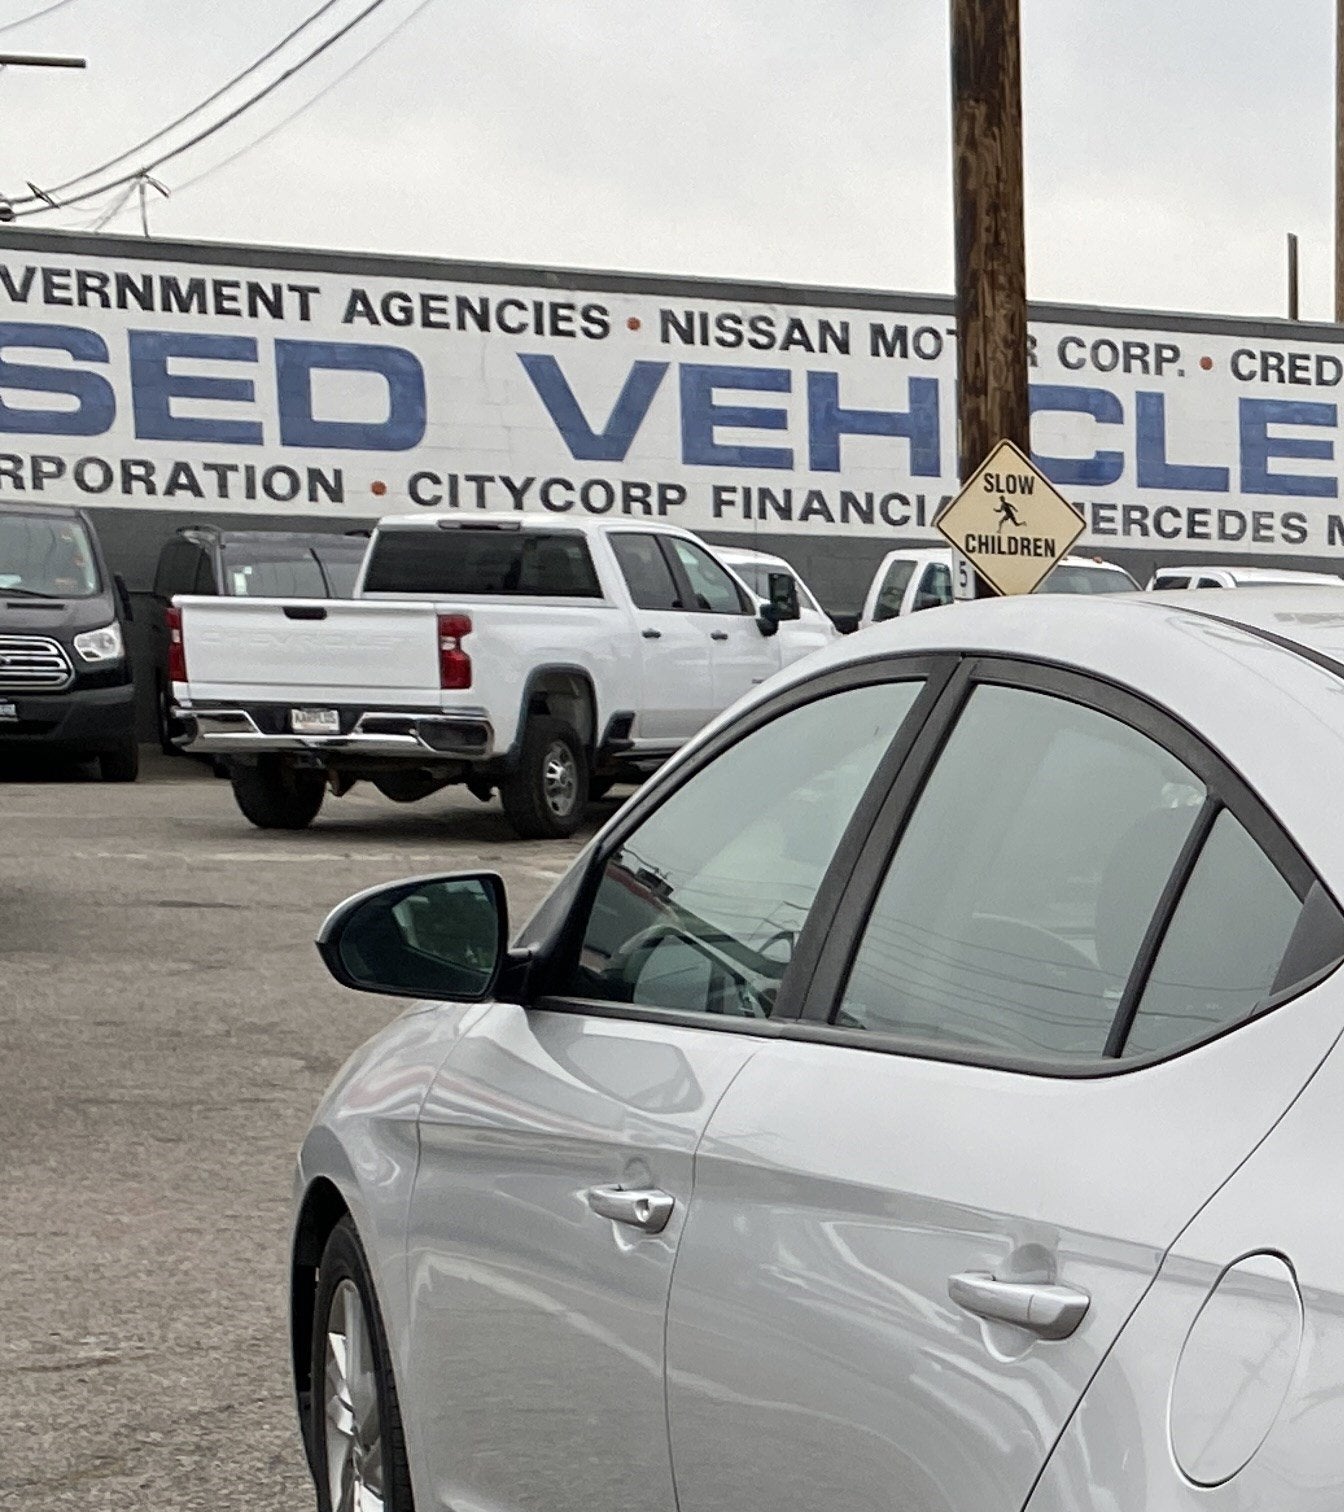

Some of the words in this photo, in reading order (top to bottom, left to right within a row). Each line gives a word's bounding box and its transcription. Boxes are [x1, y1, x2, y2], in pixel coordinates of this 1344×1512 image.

[0, 264, 320, 321] VERNMENT
[342, 288, 611, 340] AGENCIES
[659, 308, 850, 355] NISSAN
[1057, 335, 1185, 377] CORP.
[0, 322, 427, 451] SED
[408, 472, 687, 515] CITYCORP
[1071, 501, 1308, 544] ERCEDES
[983, 472, 1035, 495] SLOW
[965, 533, 1055, 558] CHILDREN
[958, 561, 968, 588] 5
